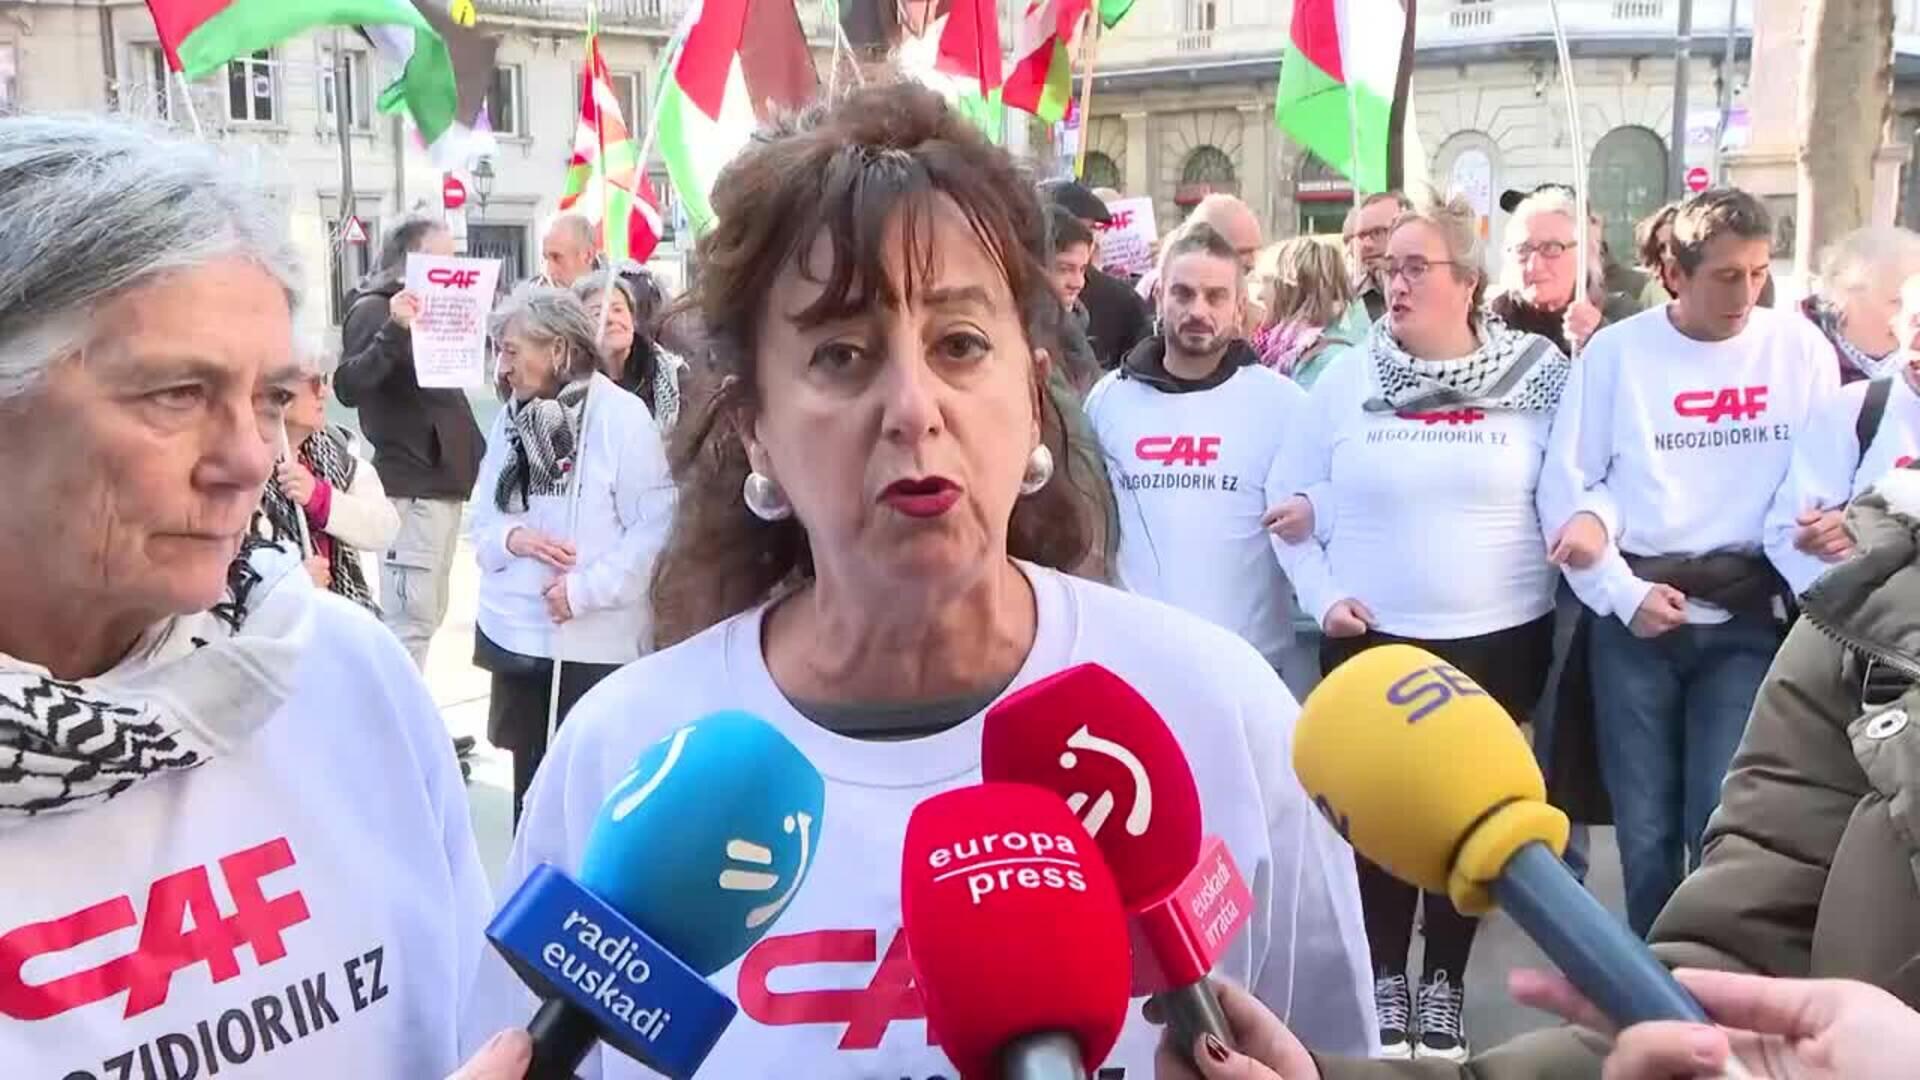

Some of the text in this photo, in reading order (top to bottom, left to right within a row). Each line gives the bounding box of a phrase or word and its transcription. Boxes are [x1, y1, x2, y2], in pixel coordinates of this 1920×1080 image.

[427, 268, 481, 289] CAF
[1674, 385, 1769, 424] CAF
[1135, 435, 1221, 467] CAF
[1367, 429, 1484, 445] NEGOZIDIORIK
[1654, 425, 1768, 452] NEGOZIDIORIK
[1221, 475, 1239, 492] EZ
[928, 831, 1077, 868] europa
[968, 867, 1087, 905] press
[1191, 853, 1231, 920] euskadi
[0, 836, 311, 1020] CAF
[562, 909, 651, 985] radio
[542, 942, 672, 1042] euskadi
[61, 945, 389, 1080] ZIDIORIK EZ
